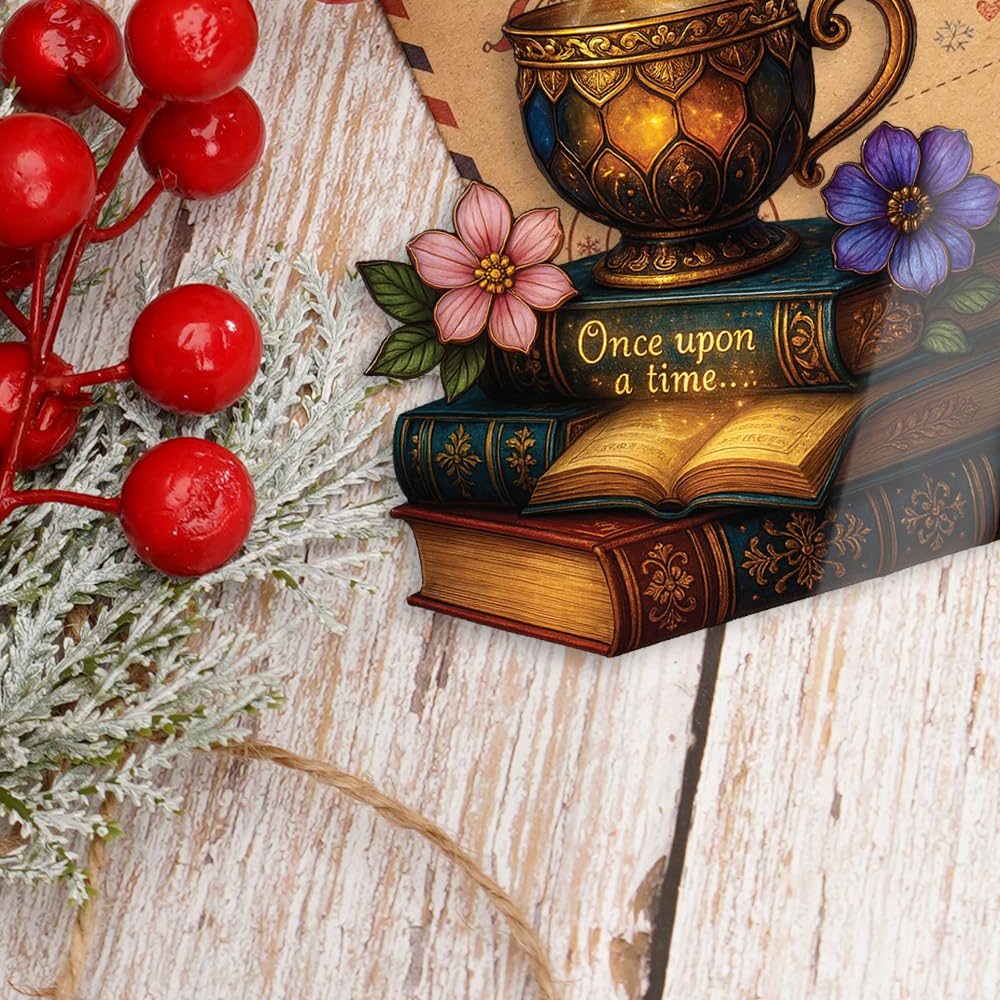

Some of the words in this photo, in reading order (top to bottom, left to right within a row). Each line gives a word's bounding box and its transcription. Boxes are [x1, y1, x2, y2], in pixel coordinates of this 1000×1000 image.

[577, 319, 663, 364] Once
[674, 327, 756, 364] upon
[614, 372, 633, 396] a
